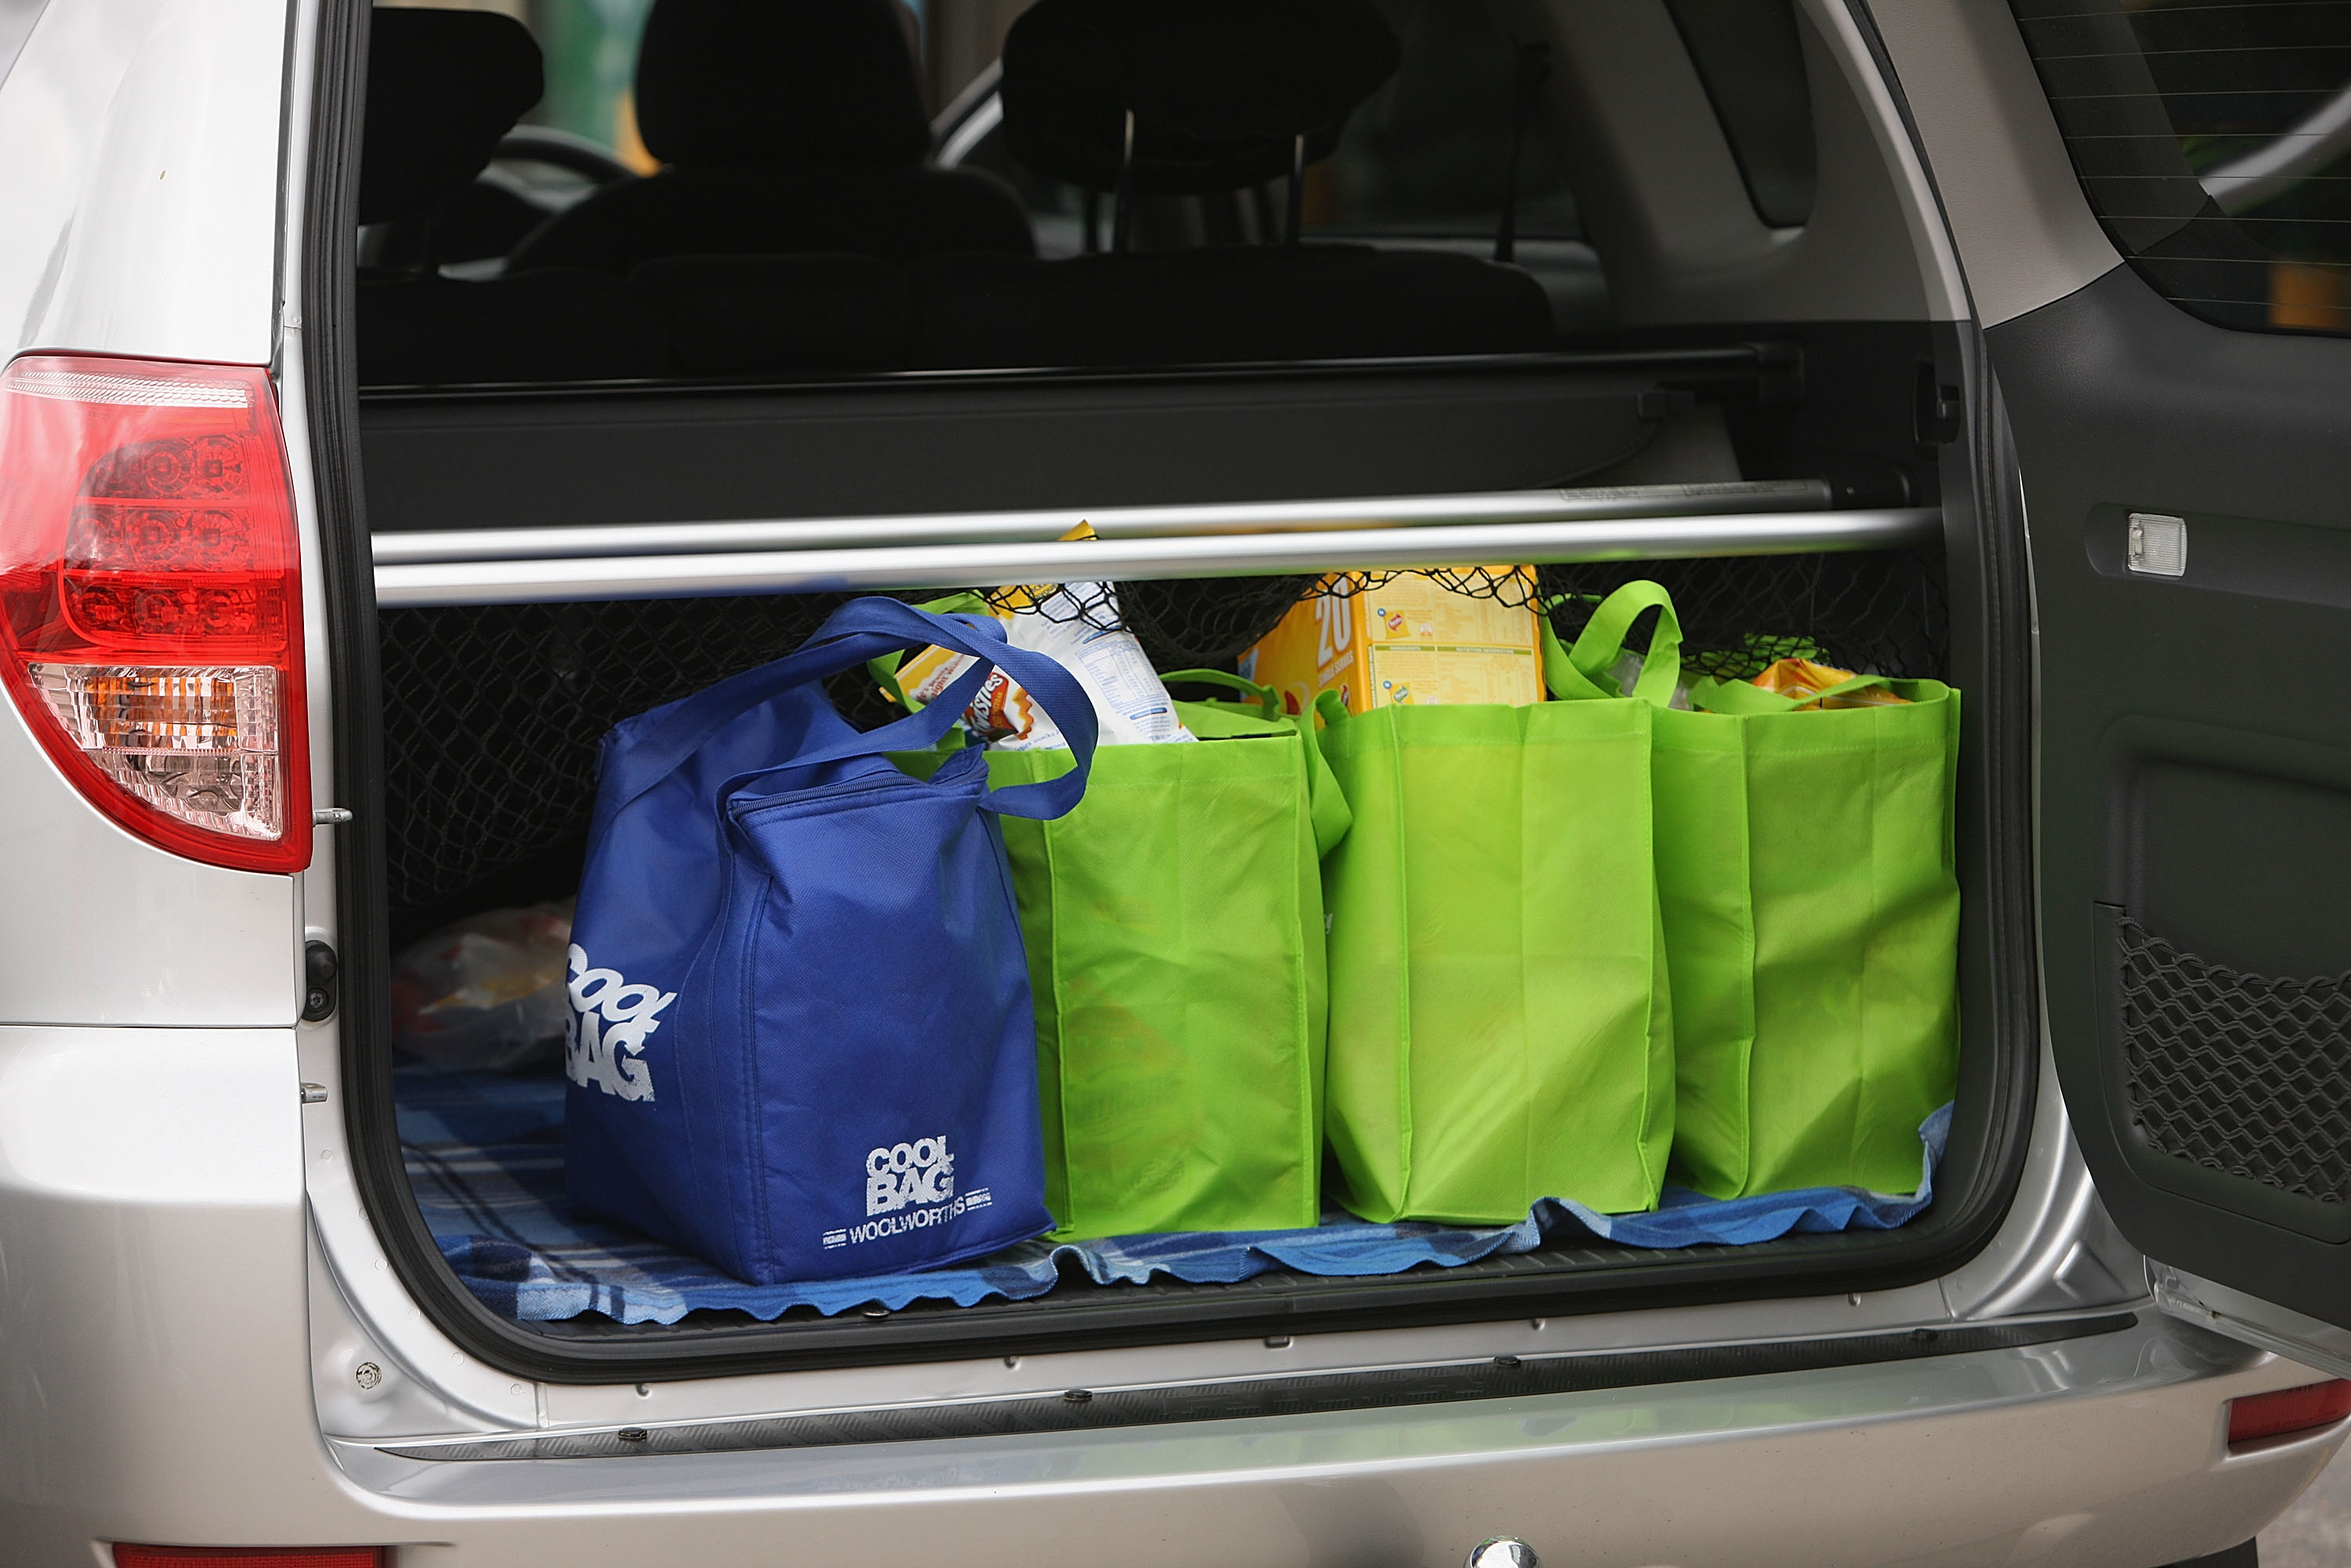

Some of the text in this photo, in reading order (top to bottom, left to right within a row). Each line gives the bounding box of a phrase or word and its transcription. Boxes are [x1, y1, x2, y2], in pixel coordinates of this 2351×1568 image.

[1314, 575, 1352, 669] 20
[567, 943, 677, 1034] COOL
[566, 1000, 655, 1102] BAG
[866, 1135, 954, 1177] COOL
[866, 1164, 954, 1216] BAG
[849, 1196, 965, 1244] WOOLWORTHS
